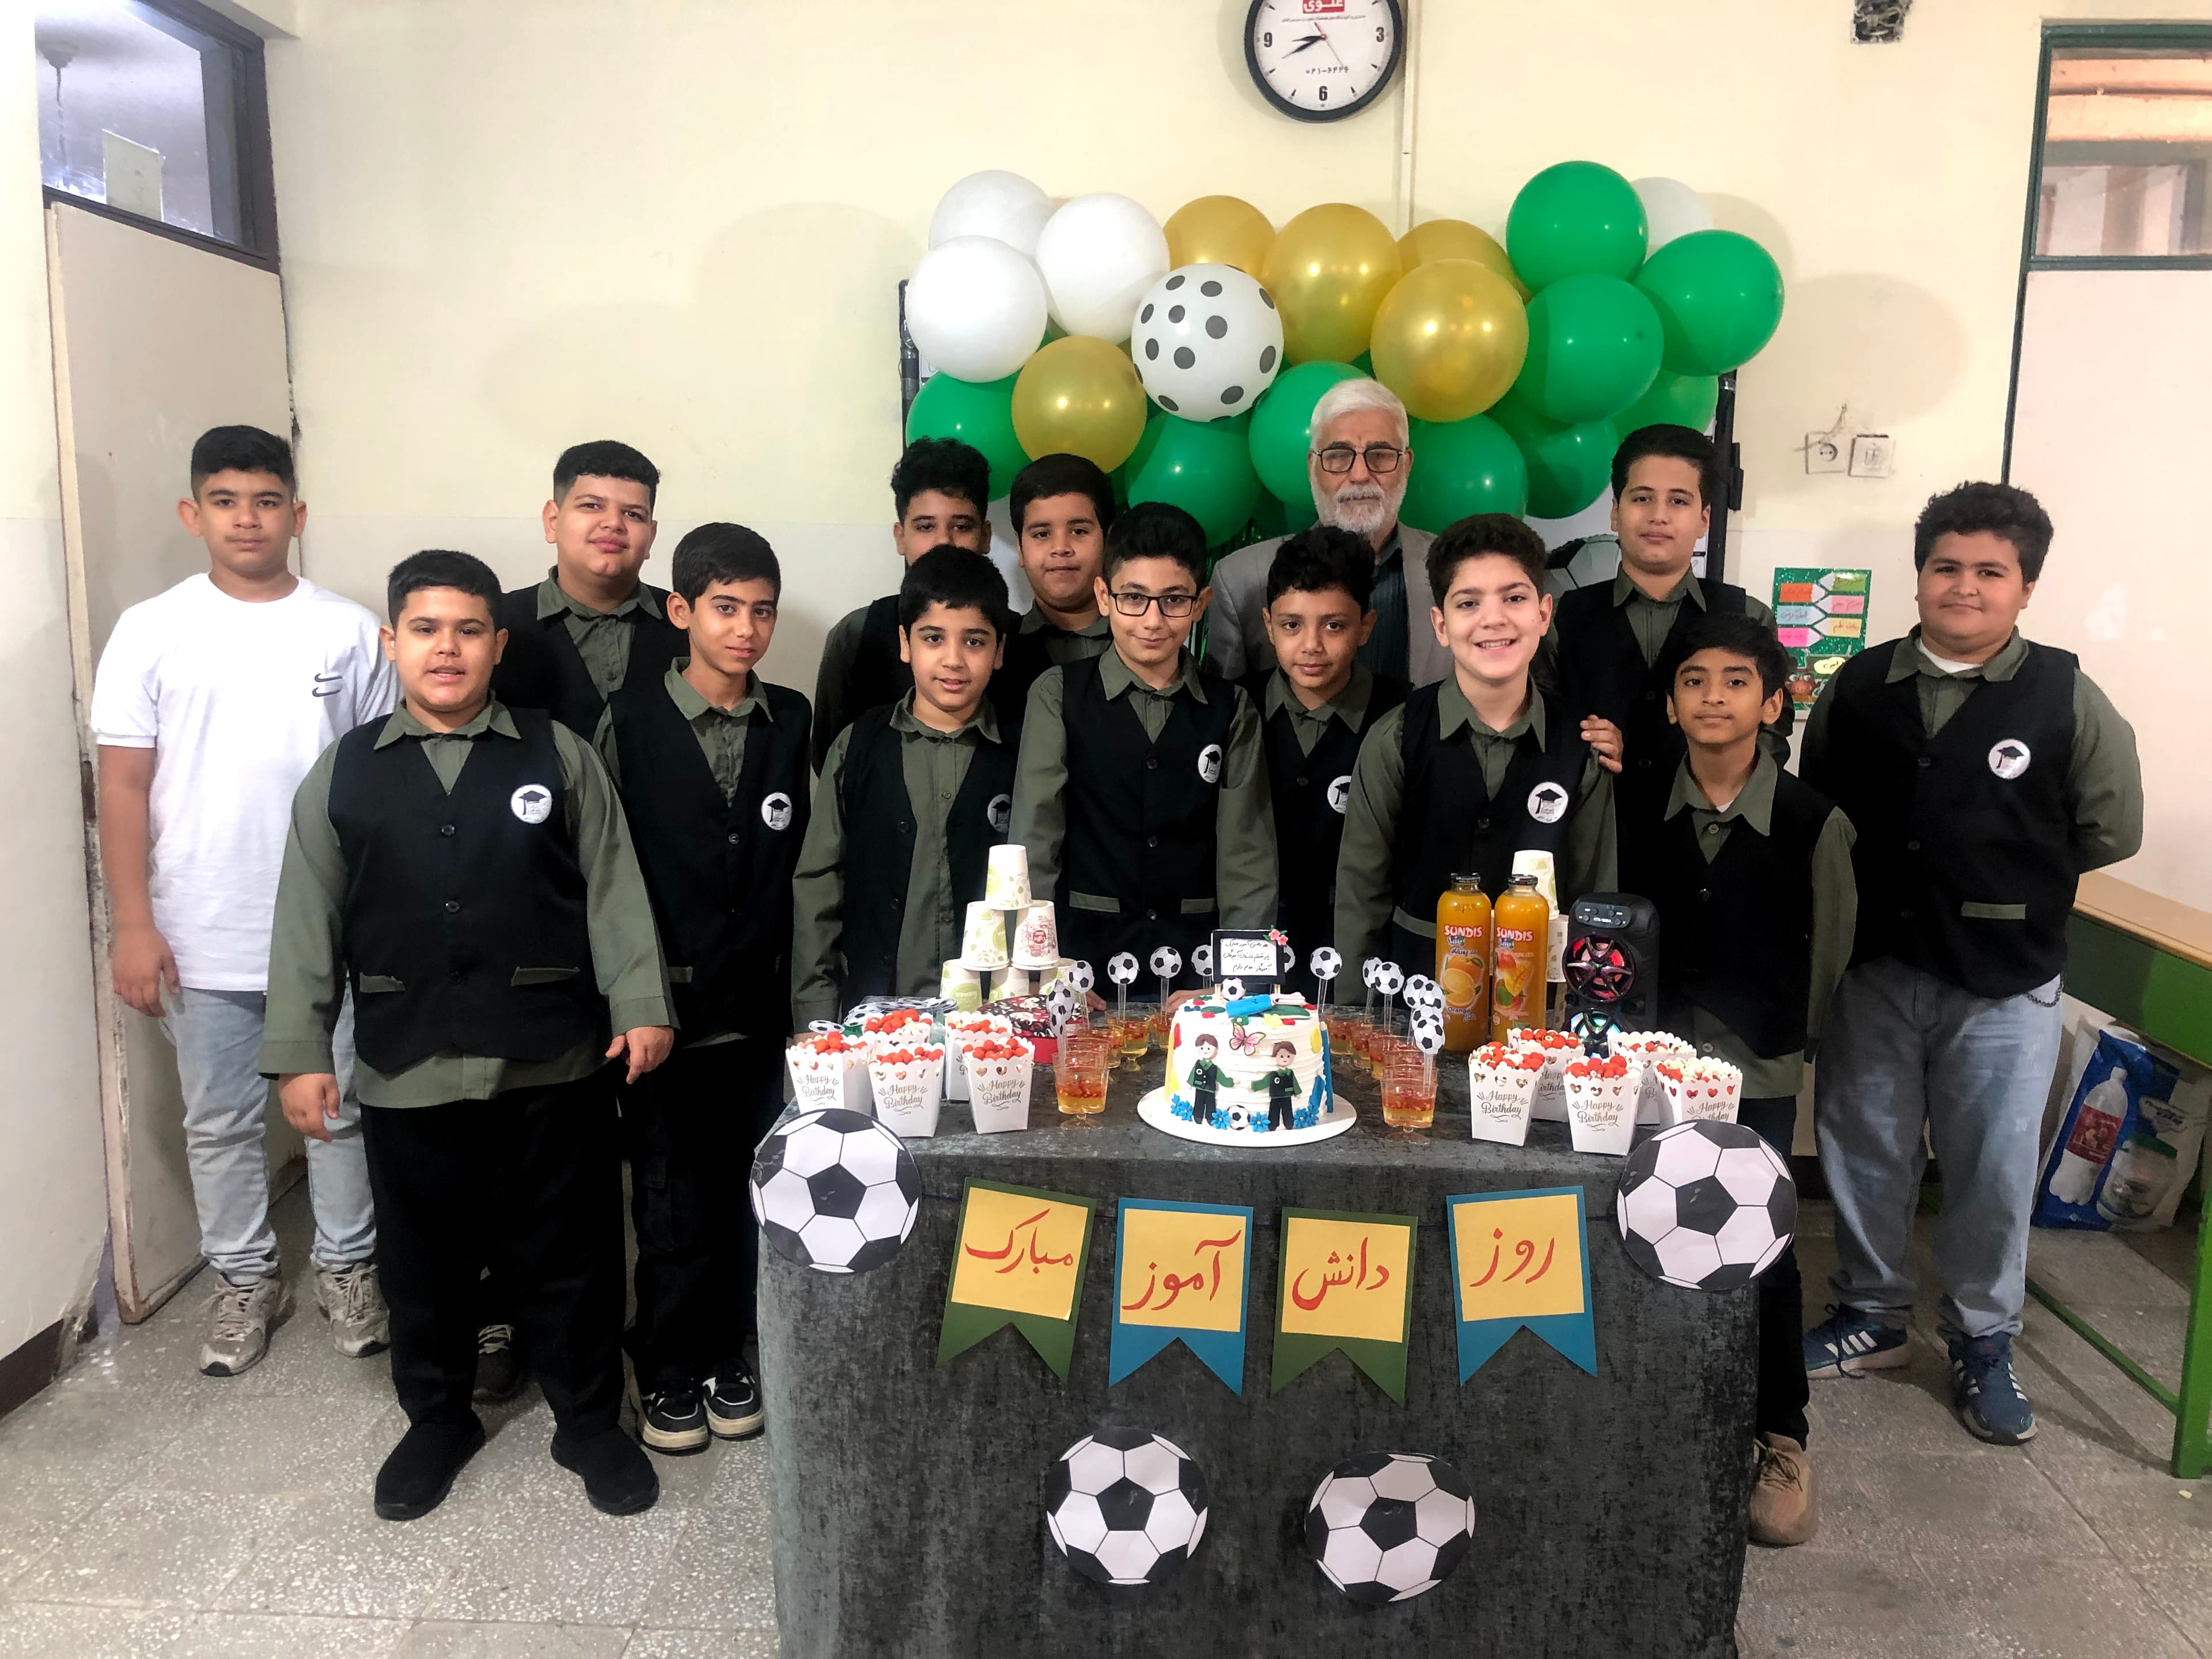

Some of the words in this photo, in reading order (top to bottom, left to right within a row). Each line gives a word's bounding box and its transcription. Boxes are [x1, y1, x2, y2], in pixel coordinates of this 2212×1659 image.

[1264, 32, 1272, 47] 9
[1376, 27, 1384, 42] 3
[1319, 86, 1327, 101] 6
[1444, 925, 1482, 937] SUNDIS
[1497, 927, 1533, 941] SUNDIS
[1225, 938, 1238, 947] مبارک
[804, 1074, 832, 1085] Happy
[1540, 1070, 1565, 1081] Happ
[802, 1085, 836, 1100] Birthday
[887, 1084, 920, 1096] Happy
[986, 1080, 1020, 1092] Happy
[1538, 1082, 1565, 1096] irthda
[884, 1095, 924, 1109] Birthday
[982, 1089, 1021, 1104] Birthday
[1486, 1090, 1521, 1103] Happy
[1481, 1101, 1521, 1120] Birthday
[1581, 1099, 1616, 1111] Happy
[1696, 1101, 1728, 1114] Happy
[1577, 1111, 1619, 1127] Birthday
[967, 1209, 1073, 1274] مبارک
[1470, 1229, 1554, 1286] روز
[1122, 1230, 1241, 1310] آموز
[1293, 1237, 1389, 1310] دانش
